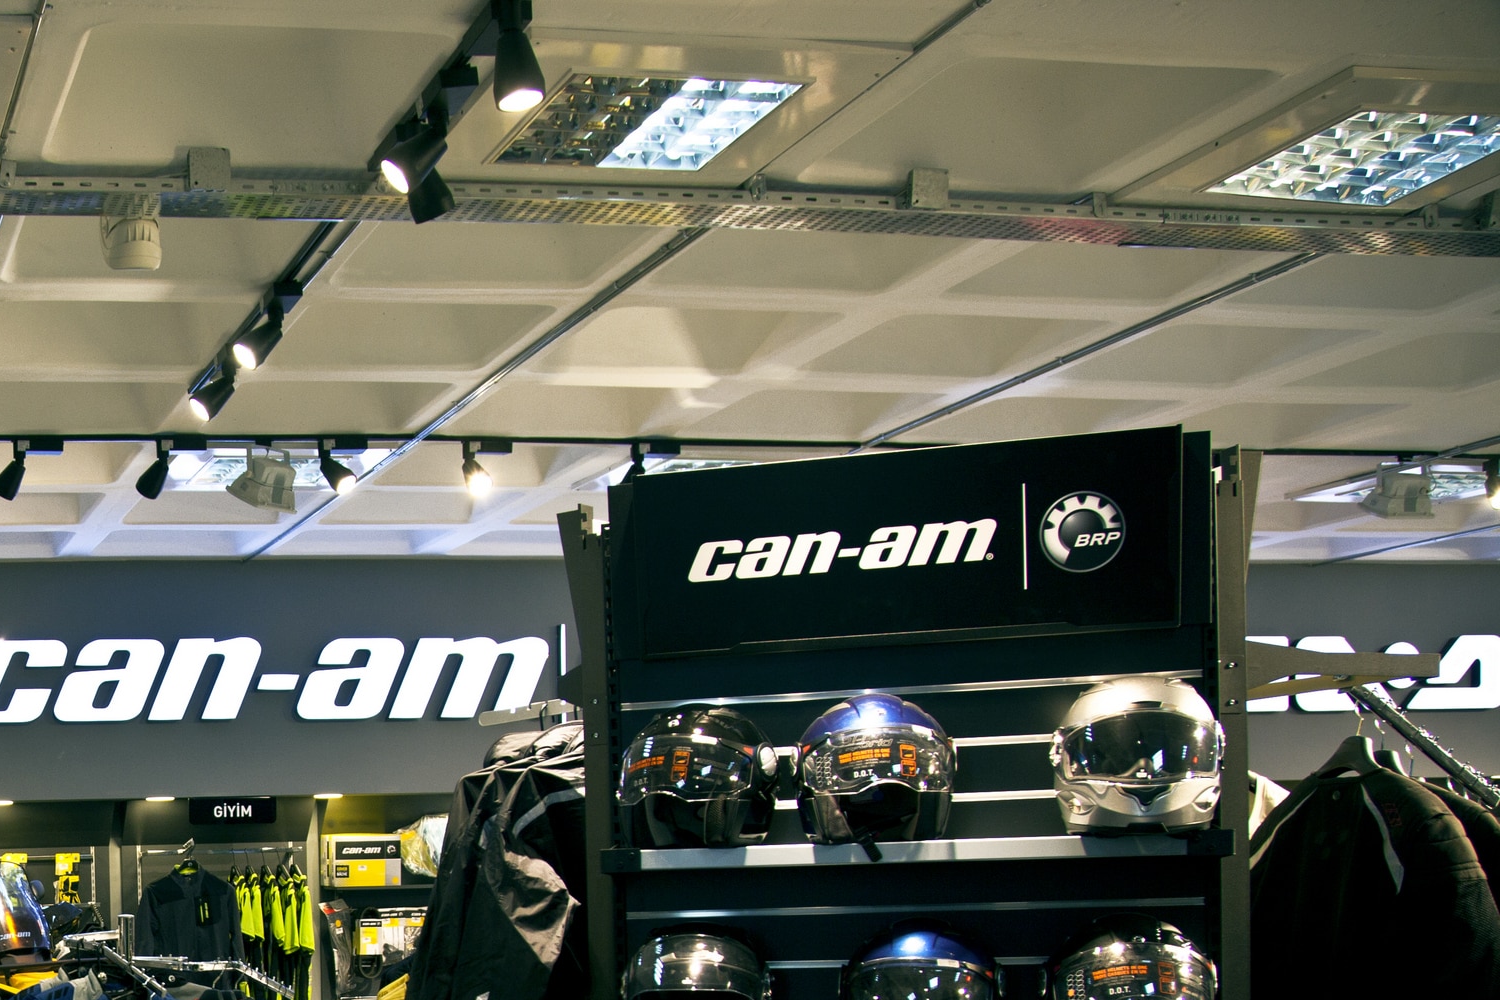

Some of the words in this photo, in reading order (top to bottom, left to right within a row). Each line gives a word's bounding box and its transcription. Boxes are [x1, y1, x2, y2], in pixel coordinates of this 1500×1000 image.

[1074, 531, 1121, 548] BRP
[688, 518, 997, 583] can-am
[213, 803, 252, 818] GİYİM
[1109, 985, 1131, 995] D.O.T.
